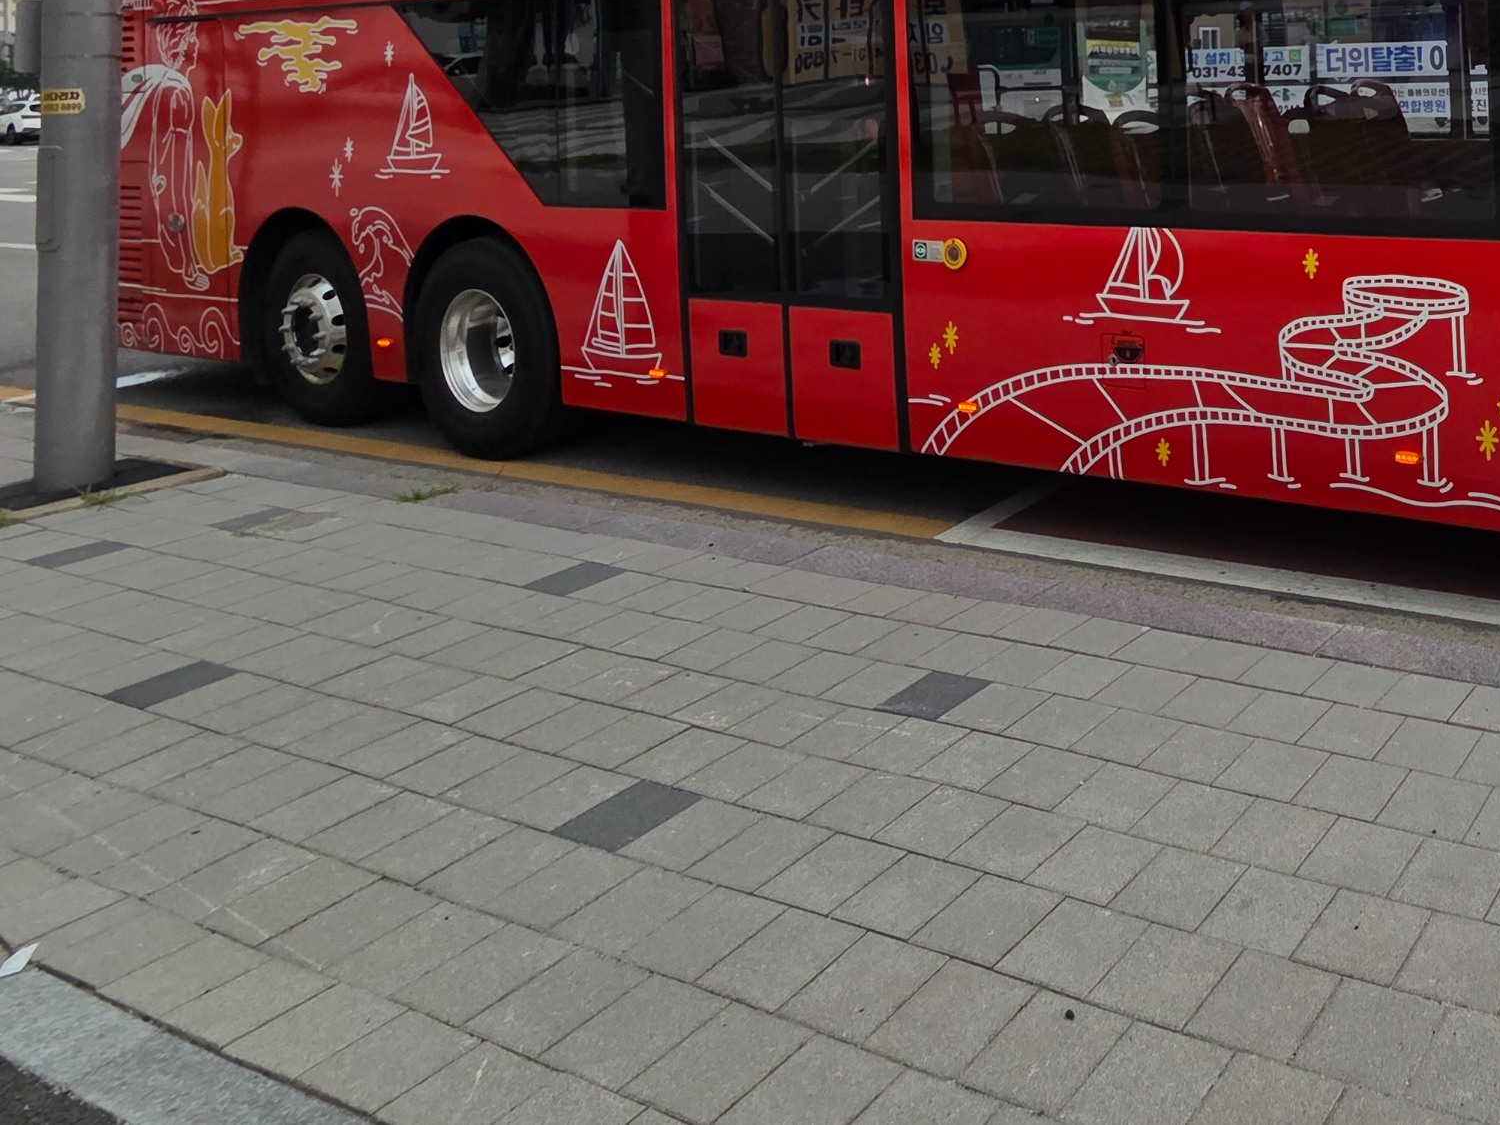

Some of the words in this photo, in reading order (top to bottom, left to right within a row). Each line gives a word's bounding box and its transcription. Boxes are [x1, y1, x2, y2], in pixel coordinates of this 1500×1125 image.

[1205, 52, 1231, 65] 설치
[1325, 45, 1423, 73] 더위탈출!
[1399, 99, 1447, 114] 연합병원
